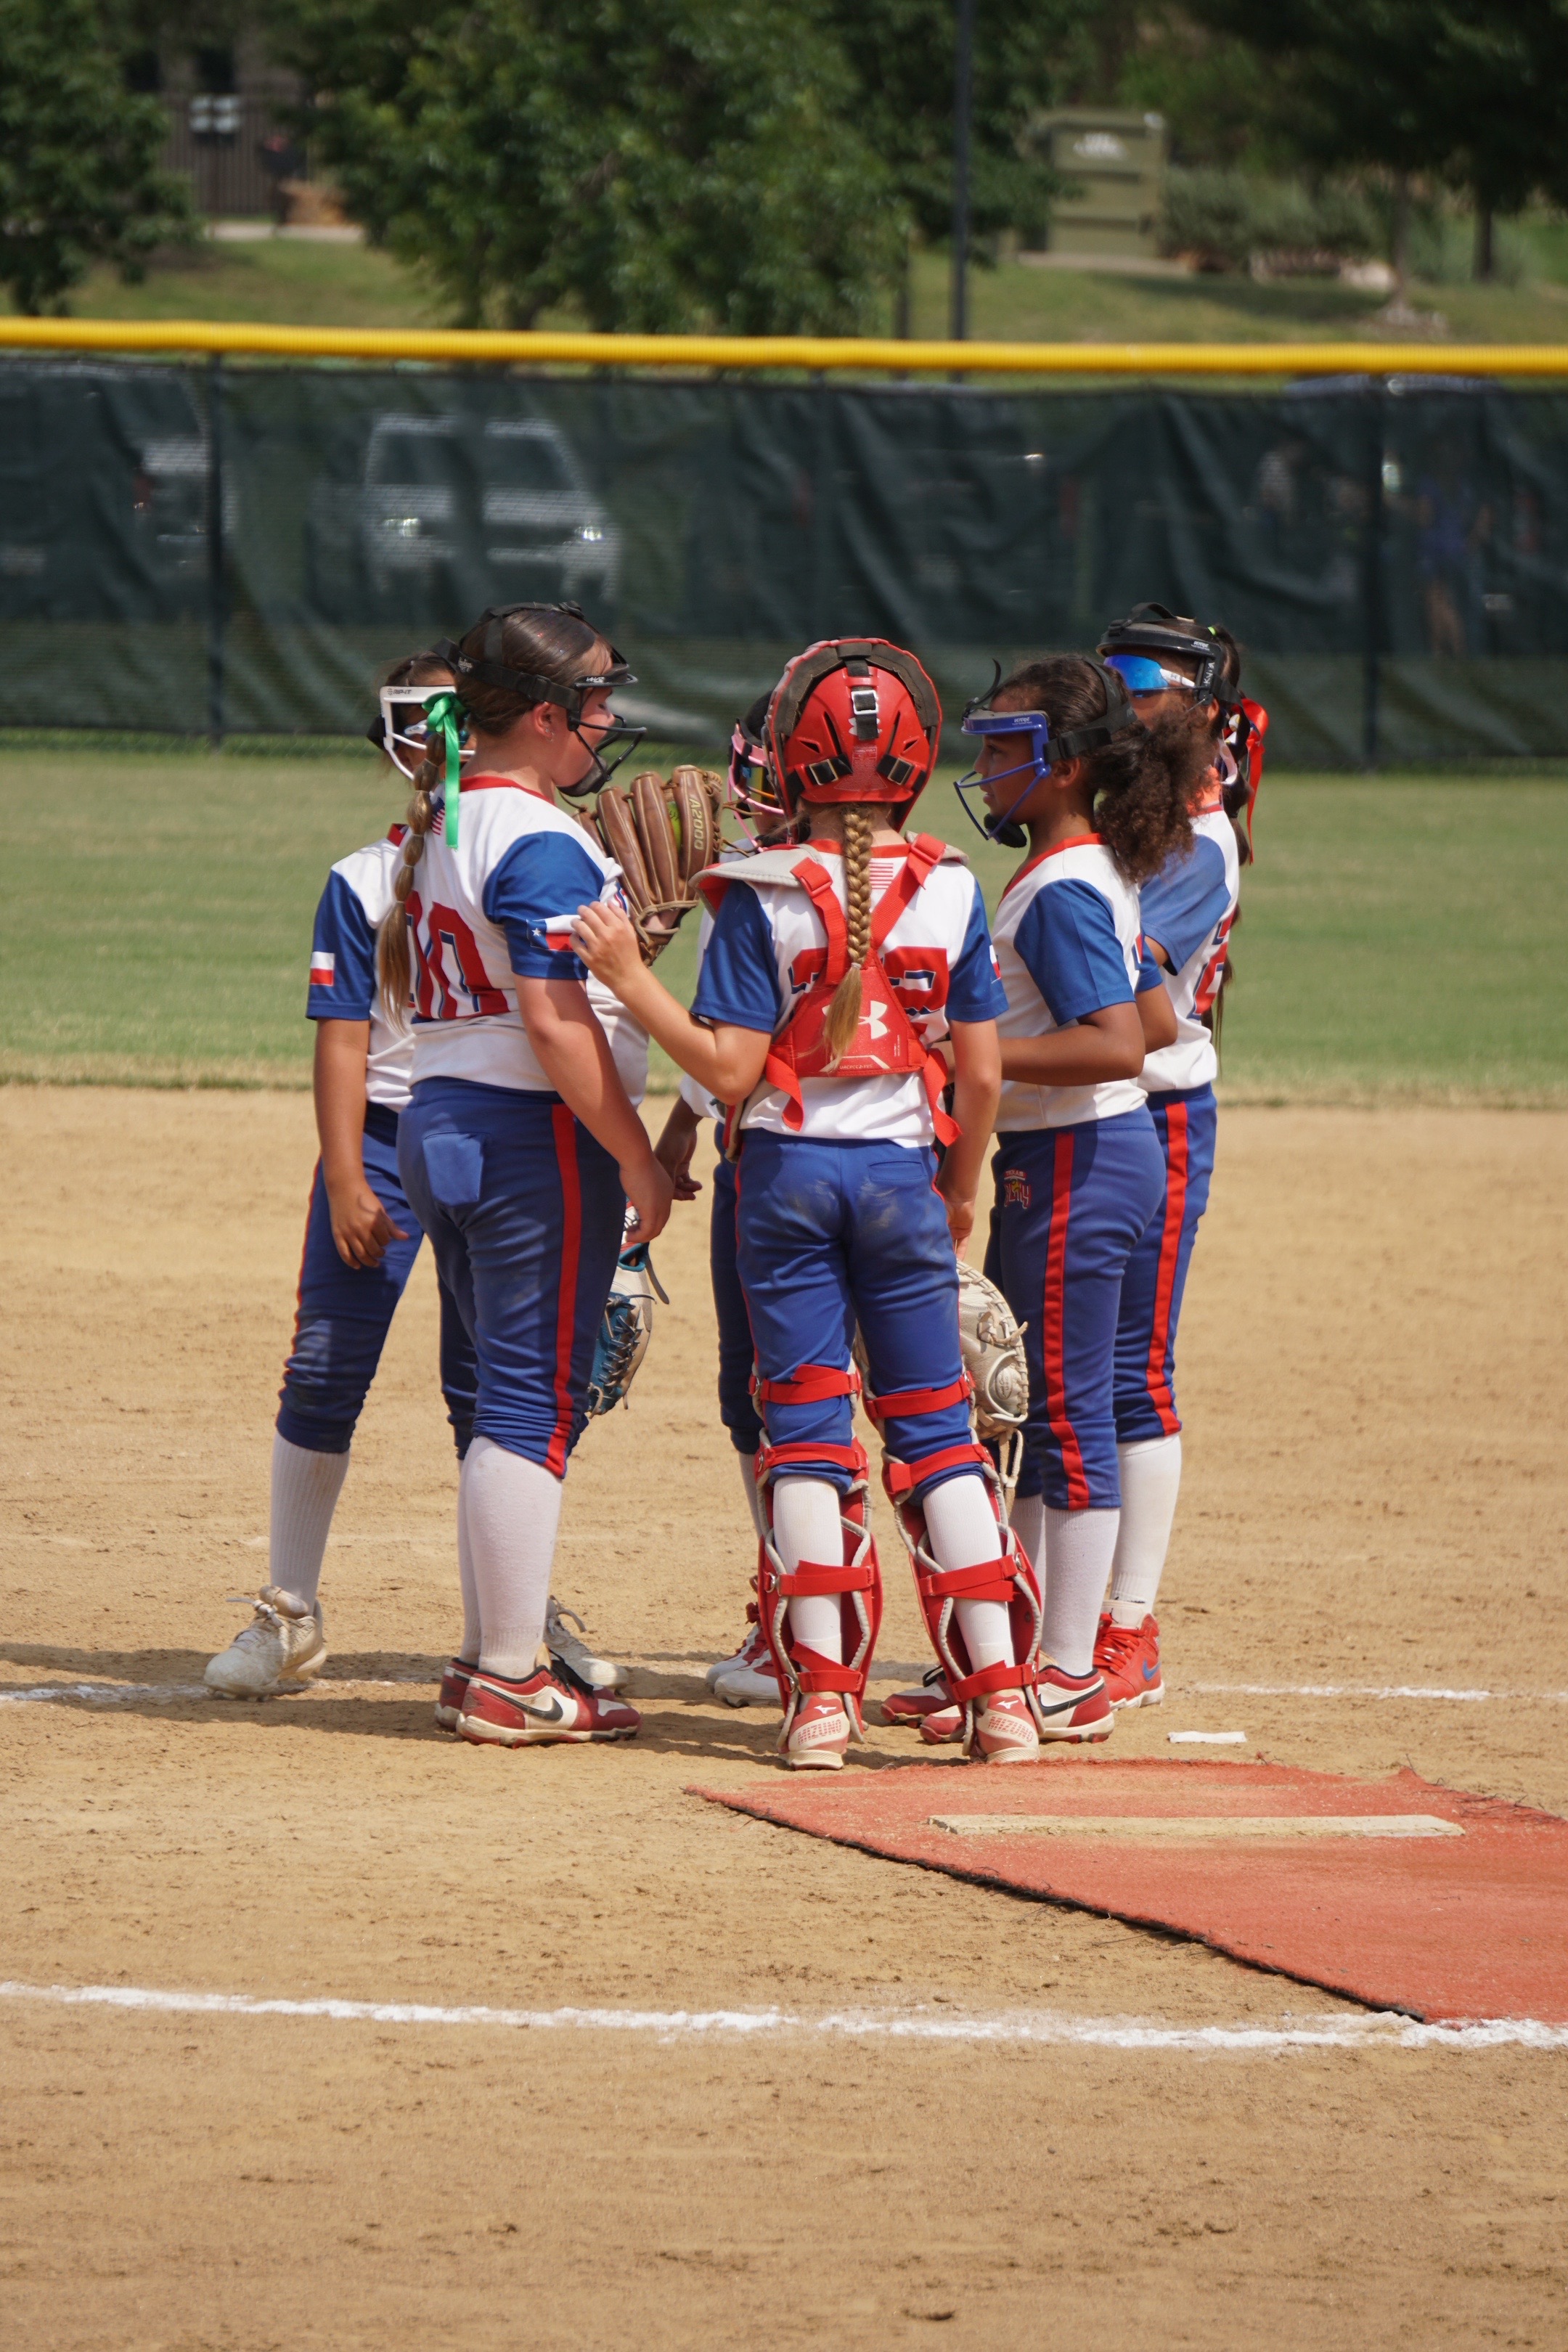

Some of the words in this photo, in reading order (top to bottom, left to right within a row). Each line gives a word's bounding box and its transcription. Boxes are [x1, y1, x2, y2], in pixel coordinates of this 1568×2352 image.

[689, 798, 704, 851] A2000
[798, 1718, 841, 1745] MIZUNO
[988, 1715, 1034, 1742] MIZUNO
